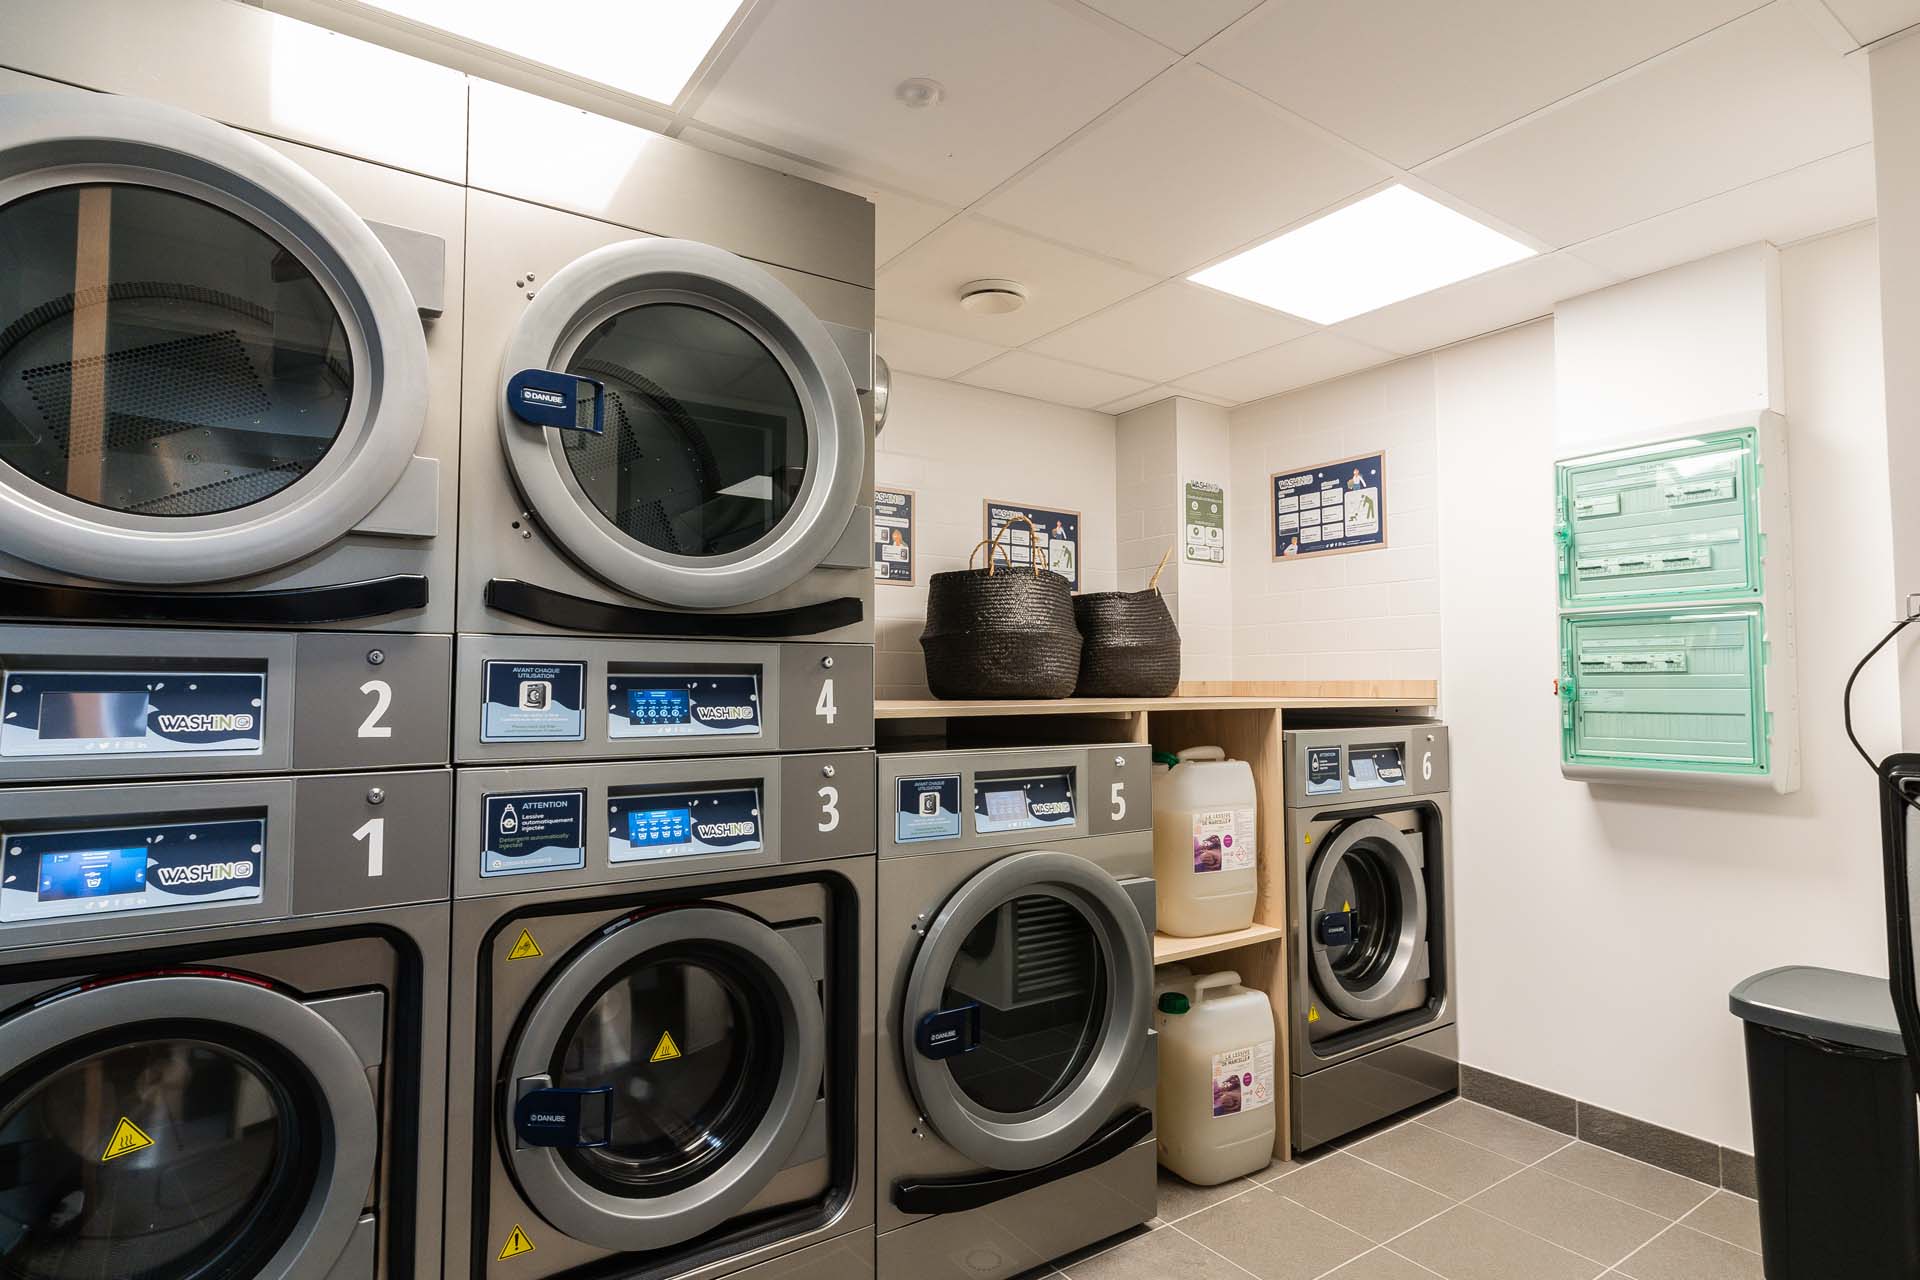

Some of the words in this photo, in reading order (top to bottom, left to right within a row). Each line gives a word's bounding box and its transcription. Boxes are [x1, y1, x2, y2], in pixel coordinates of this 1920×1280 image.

[532, 391, 563, 404] DANUBE
[357, 680, 392, 738] 2
[815, 678, 838, 724] 4
[1422, 751, 1432, 781] 6
[522, 801, 568, 809] ATTENTION
[817, 786, 840, 832] 3
[1111, 782, 1126, 820] 5
[522, 817, 574, 826] automatiquement
[352, 818, 384, 877] 1
[537, 1114, 567, 1122] DANUBE
